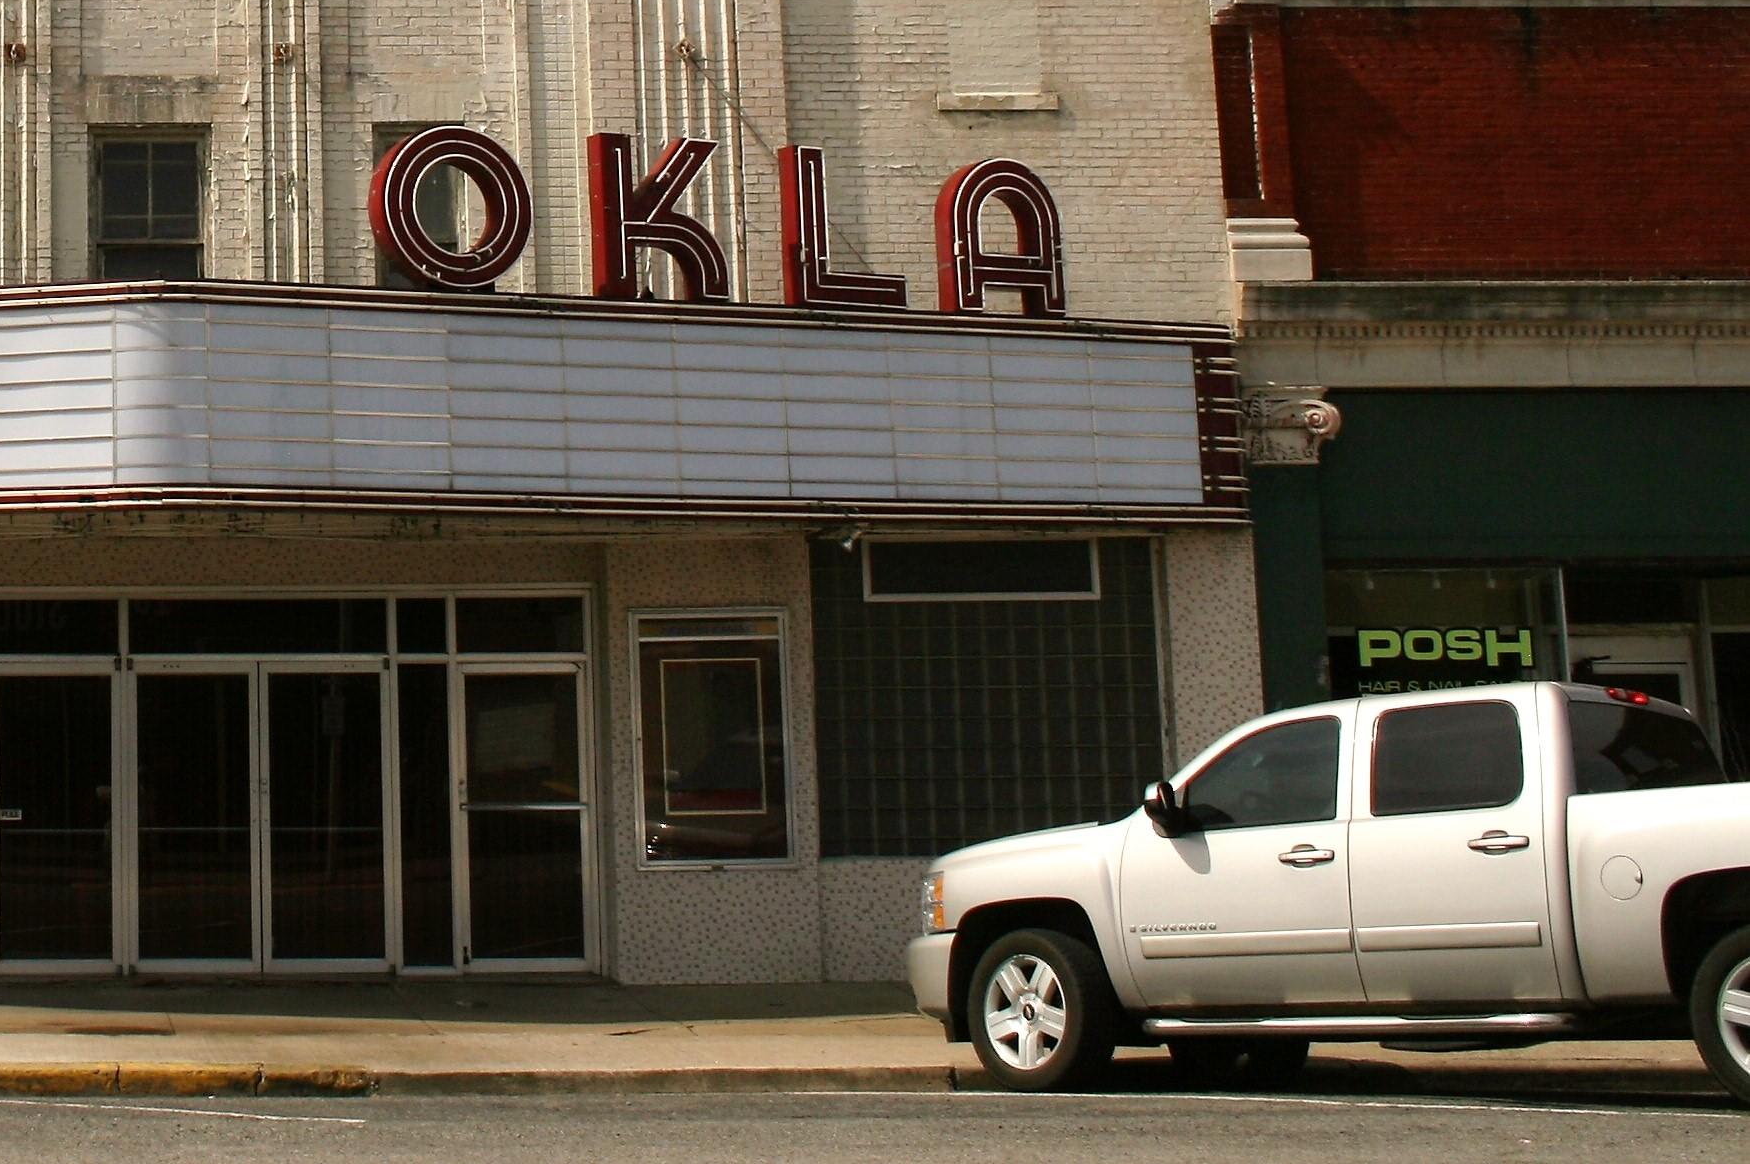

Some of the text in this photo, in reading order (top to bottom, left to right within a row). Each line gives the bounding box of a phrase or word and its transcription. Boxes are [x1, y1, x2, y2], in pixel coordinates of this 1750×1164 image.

[368, 125, 1068, 318] OKLA
[1357, 629, 1533, 667] POSH
[1357, 680, 1401, 693] HAIR
[1407, 680, 1421, 692] &
